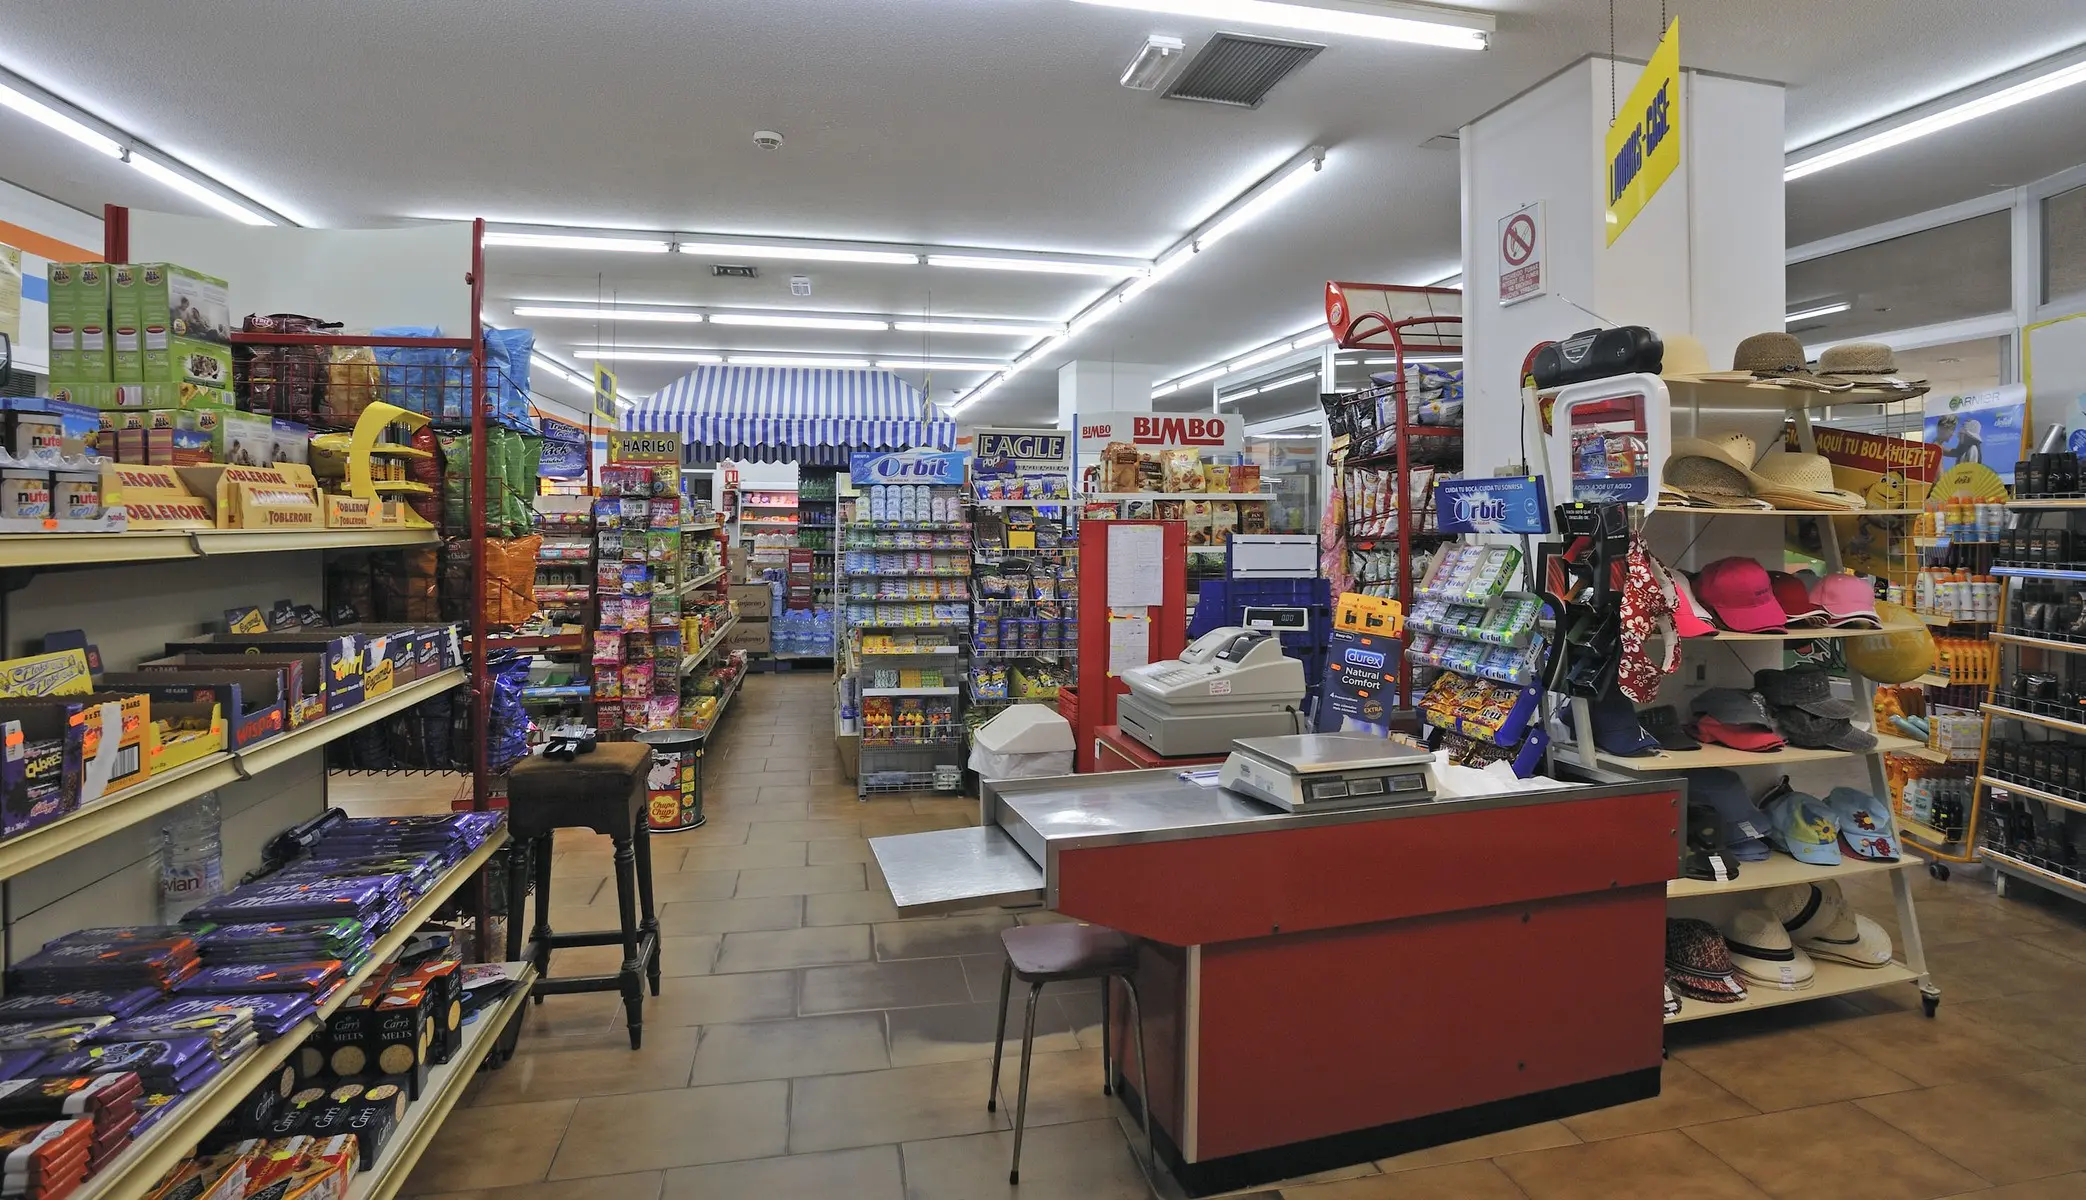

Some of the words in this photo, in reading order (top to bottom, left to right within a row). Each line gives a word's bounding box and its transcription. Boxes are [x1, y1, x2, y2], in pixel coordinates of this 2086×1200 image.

[1949, 391, 2000, 411] GARNIER
[1083, 425, 1111, 438] BIMBO
[1134, 417, 1225, 445] BIMBO
[32, 434, 62, 447] nute
[623, 440, 675, 453] HARIBO
[979, 435, 1063, 459] EAGLE
[1816, 431, 1843, 452] AQUÍ
[1845, 437, 1859, 455] TU
[877, 457, 949, 477] Orbit
[120, 471, 177, 489] ERONE
[226, 469, 287, 484] OBLERONE
[17, 491, 49, 505] nute
[69, 493, 99, 506] nute
[124, 503, 212, 523] OBLERONE
[336, 501, 369, 514] TOBLERON
[1454, 498, 1507, 522] Orbit
[268, 510, 313, 525] TOBLERONE
[339, 515, 367, 526] TOBLERONE
[1480, 632, 1502, 642] Orbit
[1348, 649, 1381, 668] durex
[365, 661, 392, 691] Caramel
[1345, 667, 1380, 680] Natural
[1486, 668, 1507, 679] Orbit
[1342, 676, 1381, 690] Comfort
[1364, 706, 1384, 714] EXTRA
[652, 800, 675, 810] Chupa
[652, 807, 675, 819] Chups
[162, 875, 200, 893] evian
[383, 1016, 409, 1030] Carr's
[333, 1031, 364, 1041] MELTS
[382, 1029, 412, 1040] MELTS
[315, 1106, 341, 1128] Carr's
[351, 1106, 376, 1129] Carr's
